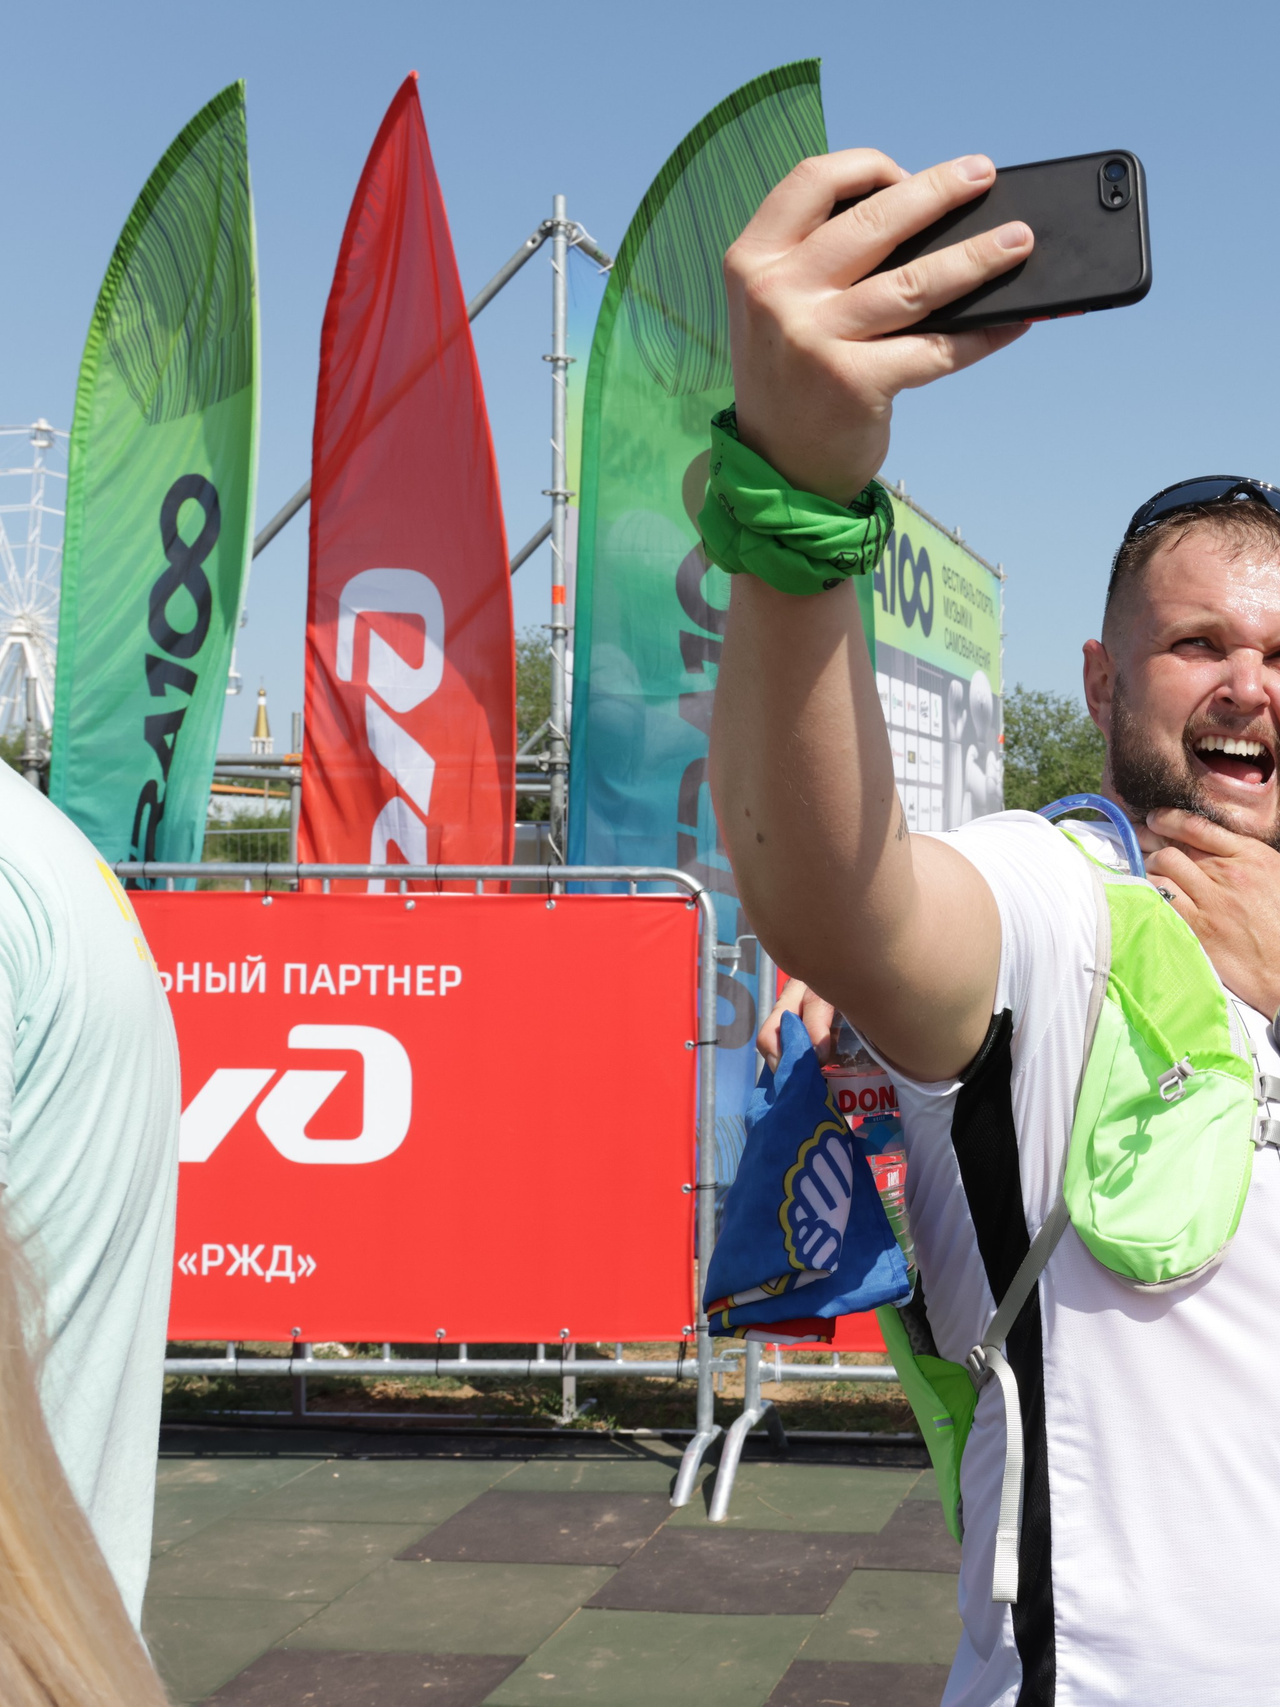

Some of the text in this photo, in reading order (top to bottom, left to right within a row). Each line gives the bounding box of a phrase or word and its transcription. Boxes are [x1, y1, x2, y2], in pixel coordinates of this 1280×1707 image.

[283, 963, 462, 996] ПАРТНЕР
[838, 1085, 899, 1113] DON
[177, 1243, 317, 1284] «РЖД»
